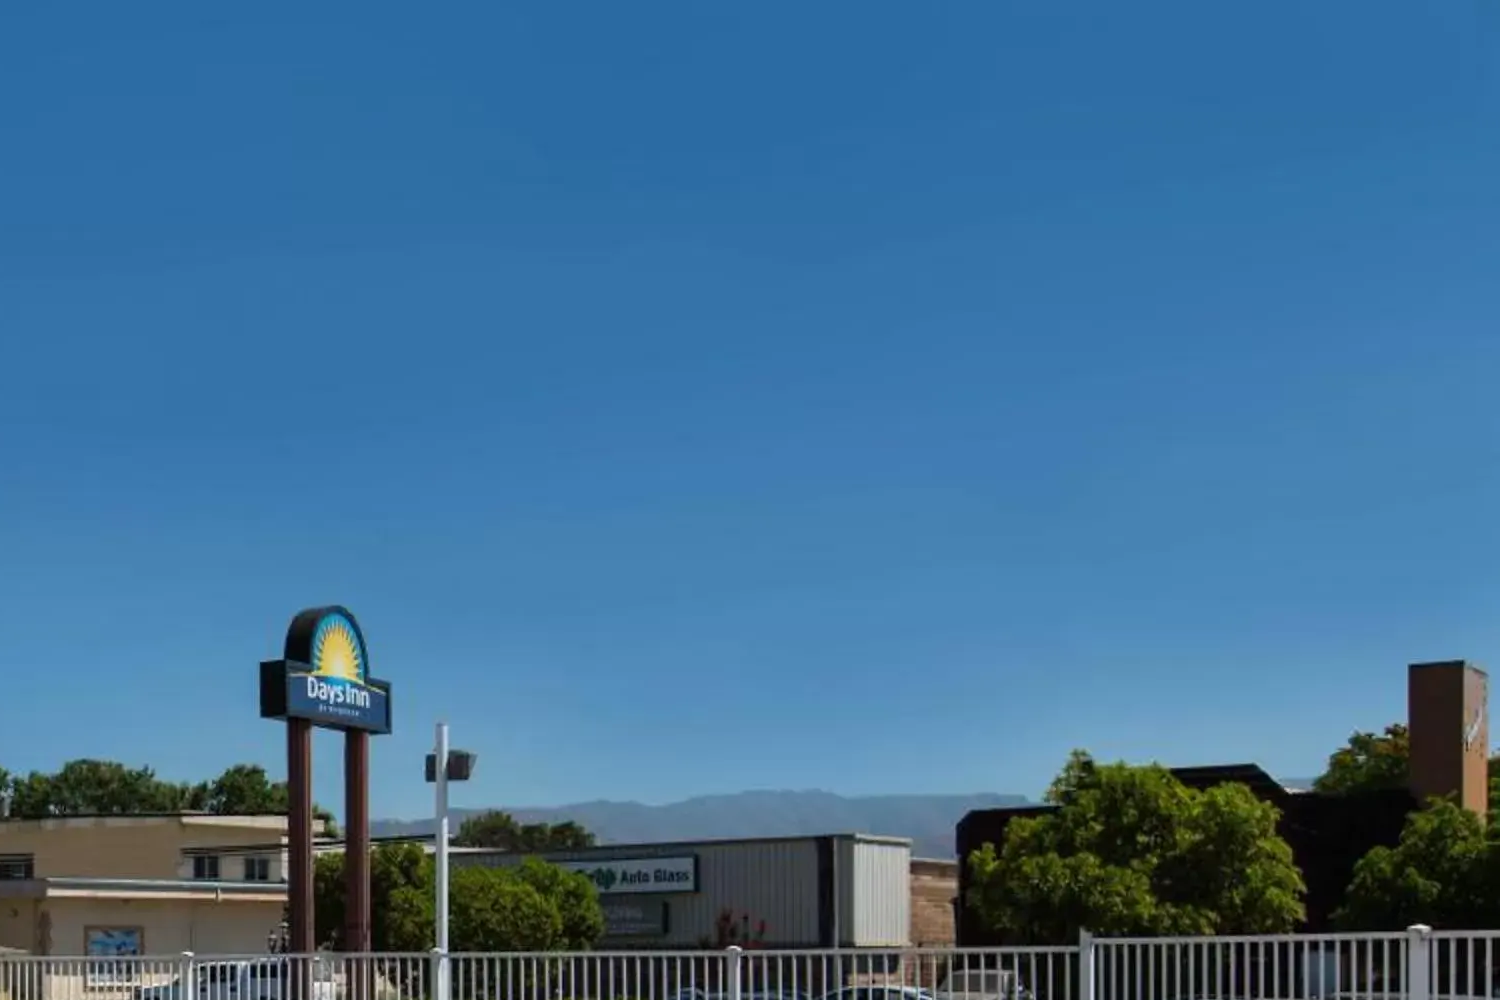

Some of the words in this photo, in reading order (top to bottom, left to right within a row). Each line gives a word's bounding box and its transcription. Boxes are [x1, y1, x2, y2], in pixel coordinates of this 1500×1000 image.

[307, 676, 344, 705] Days
[345, 683, 370, 708] Inn
[621, 869, 649, 885] Auto
[653, 868, 689, 883] Glass
